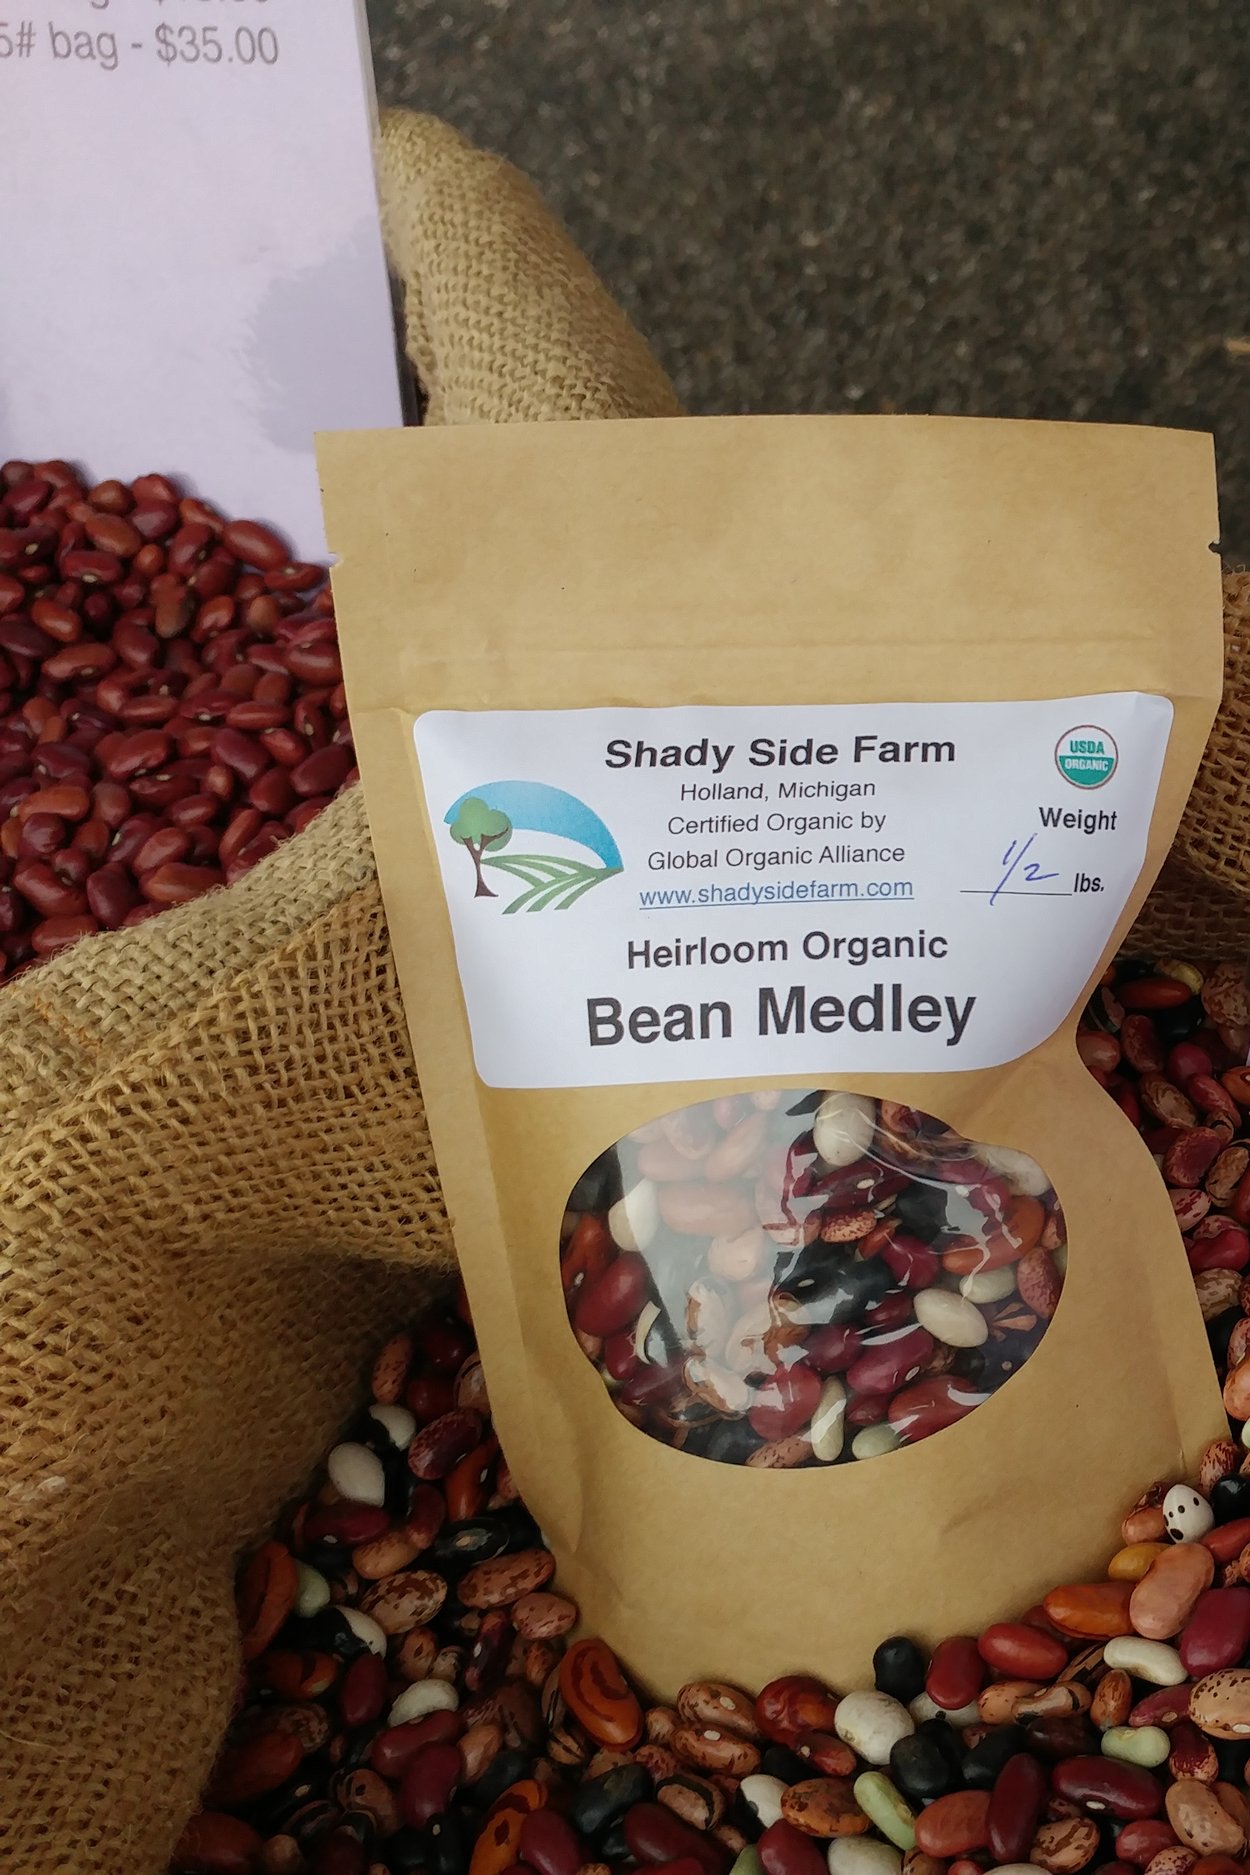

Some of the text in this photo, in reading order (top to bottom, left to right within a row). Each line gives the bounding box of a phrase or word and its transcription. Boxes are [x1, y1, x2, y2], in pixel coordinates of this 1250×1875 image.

[48, 21, 118, 70] bag
[154, 22, 279, 67] $35.00
[604, 735, 956, 775] Shady Side Farm
[1069, 740, 1105, 755] USDA
[1064, 758, 1109, 772] ORGANIC
[680, 780, 876, 802] Holland, Michigan
[667, 811, 887, 835] Certified Organic by
[1038, 806, 1117, 835] Weight
[648, 845, 906, 871] Global Organic Alliance
[990, 832, 1060, 907] 1/2
[639, 879, 914, 909] www.shadysidefarm.com
[1074, 873, 1105, 893] lbs.
[627, 929, 949, 970] Heirloom Organic
[585, 983, 977, 1048] Bean Medley
